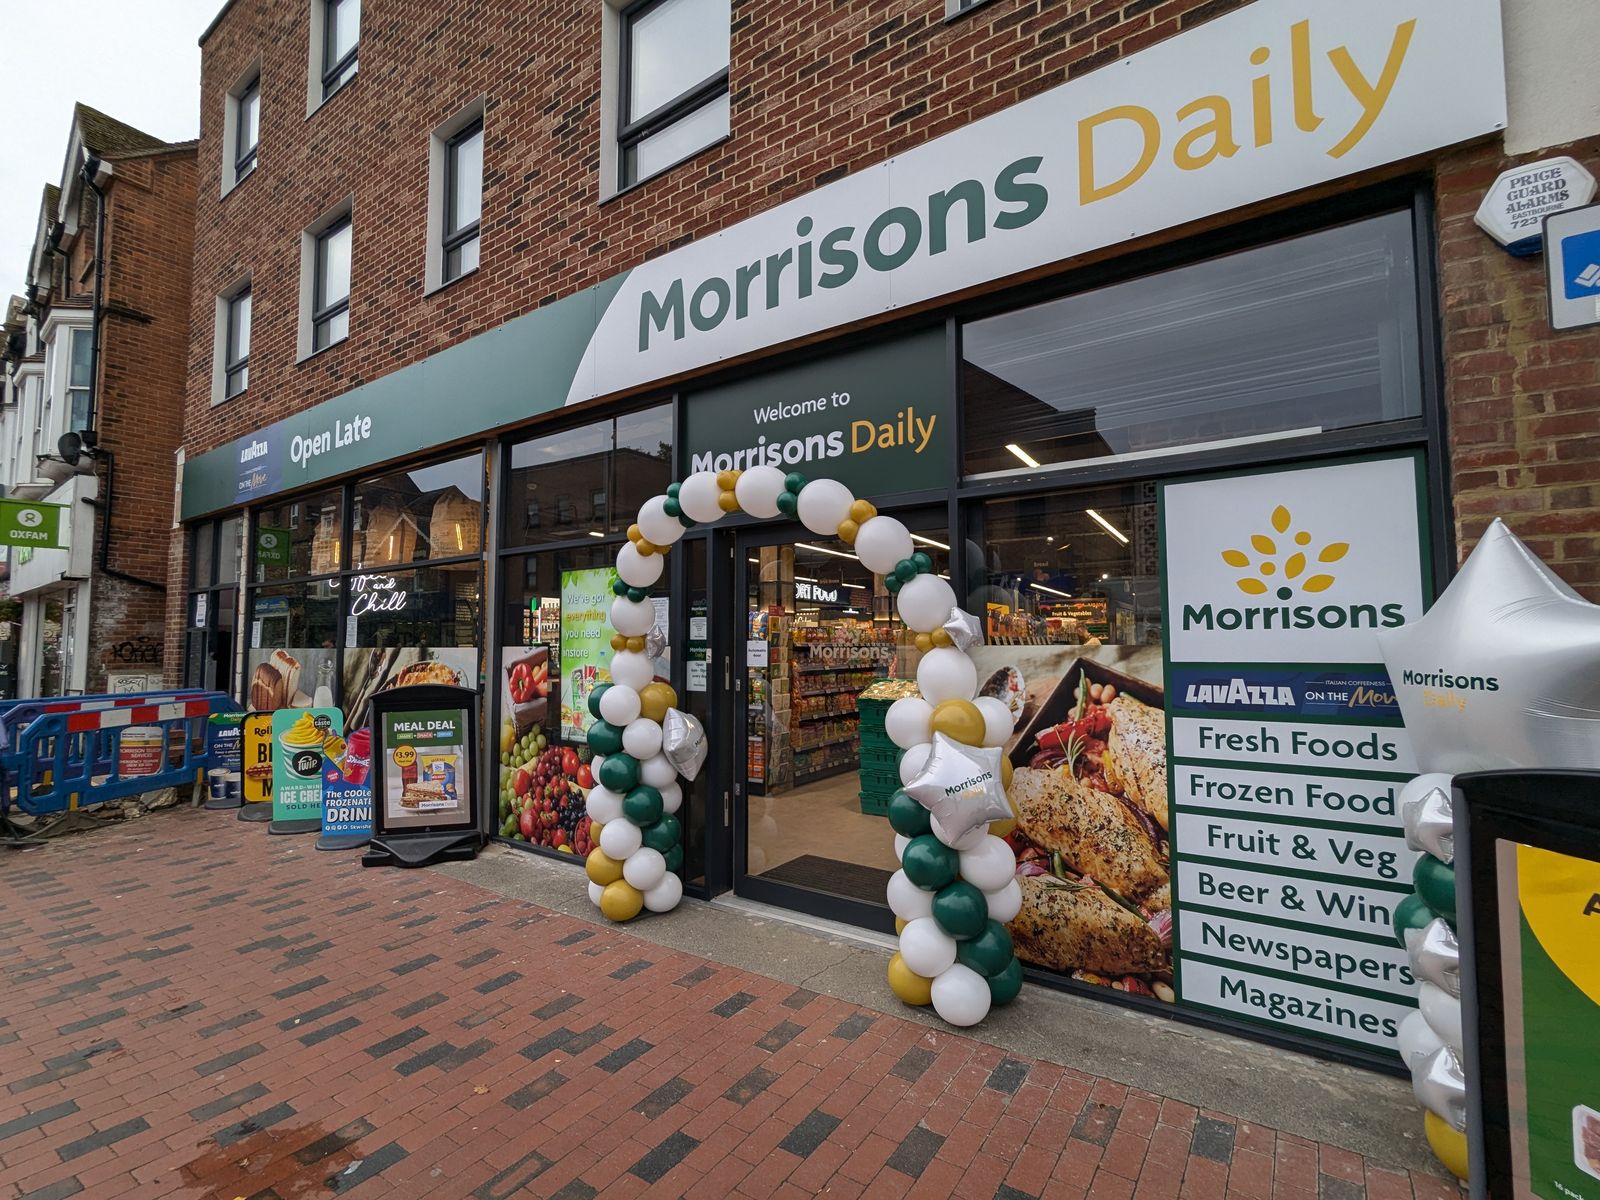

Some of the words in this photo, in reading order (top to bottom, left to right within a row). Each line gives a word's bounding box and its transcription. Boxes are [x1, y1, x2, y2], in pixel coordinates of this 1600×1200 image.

[638, 155, 1048, 353] Morrisons
[1077, 18, 1417, 207] Daily
[1507, 178, 1567, 201] GUARD
[1509, 167, 1562, 189] PRICE
[1505, 189, 1570, 214] ALARMS
[1512, 202, 1564, 220] EASTBOURNE
[754, 397, 827, 425] Welcome
[831, 391, 851, 408] to
[290, 431, 331, 468] Open
[335, 414, 372, 449] Late
[691, 430, 845, 475] Morrisons
[851, 406, 937, 454] Daily
[9, 529, 48, 540] OXFAM
[373, 578, 397, 590] and
[352, 591, 407, 616] Chill
[567, 609, 607, 623] everything
[1182, 588, 1406, 631] Morrisons
[565, 630, 579, 640] you
[581, 628, 601, 639] need
[809, 640, 890, 660] Morrisons
[1185, 678, 1296, 706] LAVAZZA
[1402, 668, 1500, 692] Morrisons
[1305, 691, 1325, 701] ON
[1327, 692, 1349, 702] THE
[1349, 686, 1398, 708] Mov
[394, 722, 425, 731] MEAL
[427, 720, 456, 730] DEAL
[1199, 726, 1280, 754] Fresh
[1292, 730, 1398, 761] Foods
[326, 790, 342, 798] The
[944, 771, 993, 797] Morrisons
[1190, 774, 1294, 806] Frozen
[1306, 783, 1396, 816] Food
[280, 791, 297, 804] ICE
[1207, 824, 1281, 856] Fruit
[1291, 834, 1318, 861] &
[1328, 838, 1399, 879] Veg
[1198, 872, 1270, 905] Beer
[1280, 884, 1306, 911] &
[1316, 889, 1390, 926] Win
[1201, 921, 1416, 986] Newspapers
[1219, 975, 1399, 1039] Magazines
